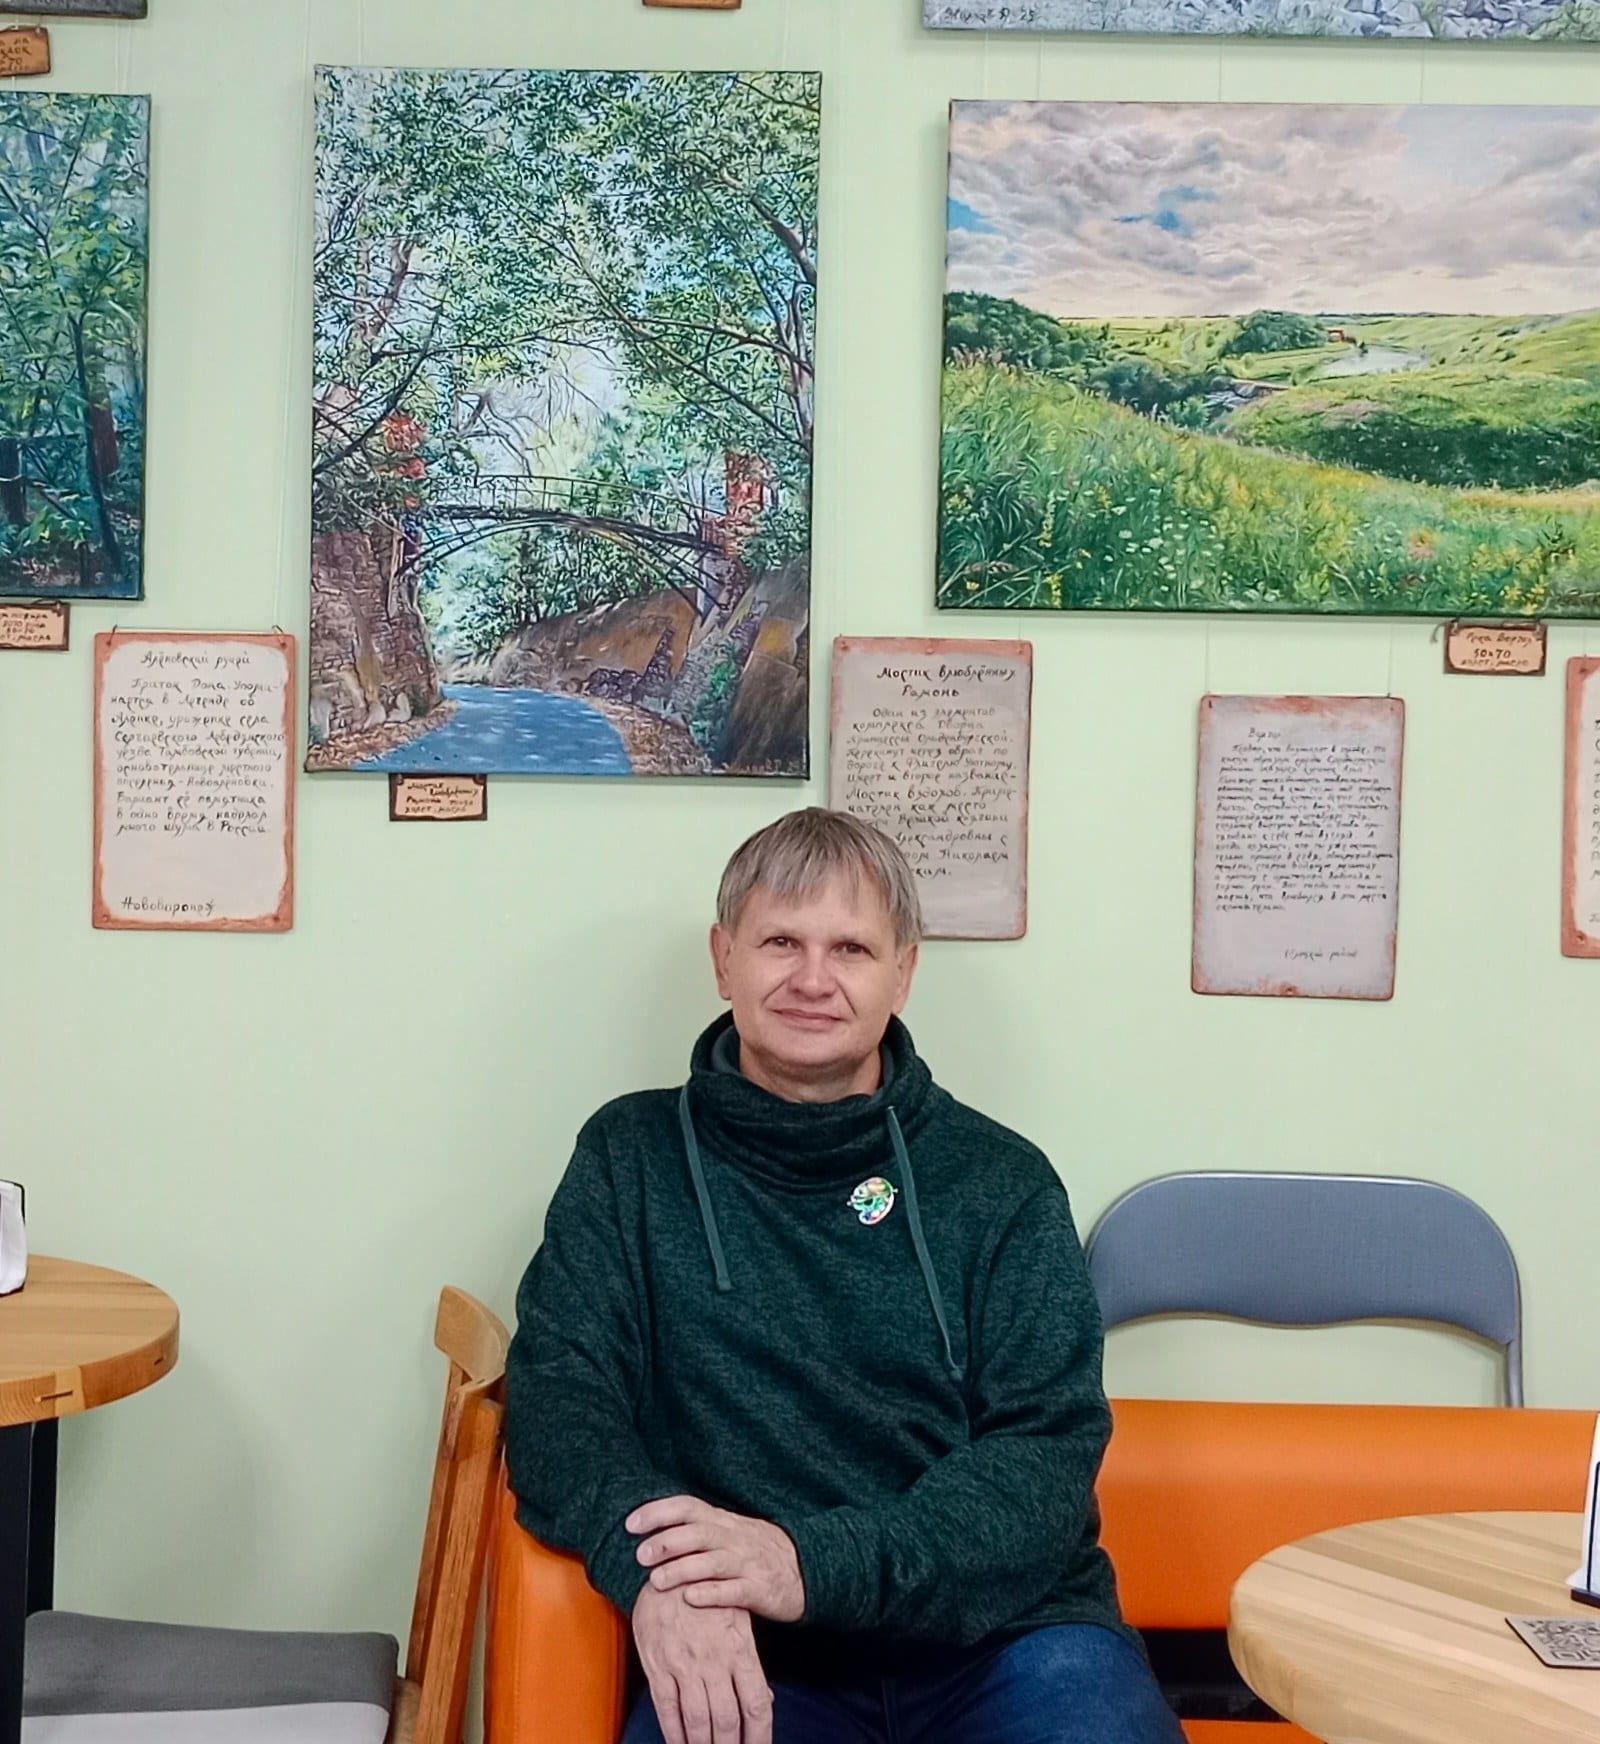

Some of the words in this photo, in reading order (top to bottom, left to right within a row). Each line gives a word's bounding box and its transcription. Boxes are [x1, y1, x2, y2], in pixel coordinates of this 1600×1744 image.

[214, 652, 251, 669] ручей
[877, 667, 932, 683] Мостик
[131, 678, 183, 695] Приток
[902, 684, 960, 700] Рамонь
[873, 707, 903, 719] Один
[846, 786, 900, 801] Мостик
[911, 803, 936, 814] как
